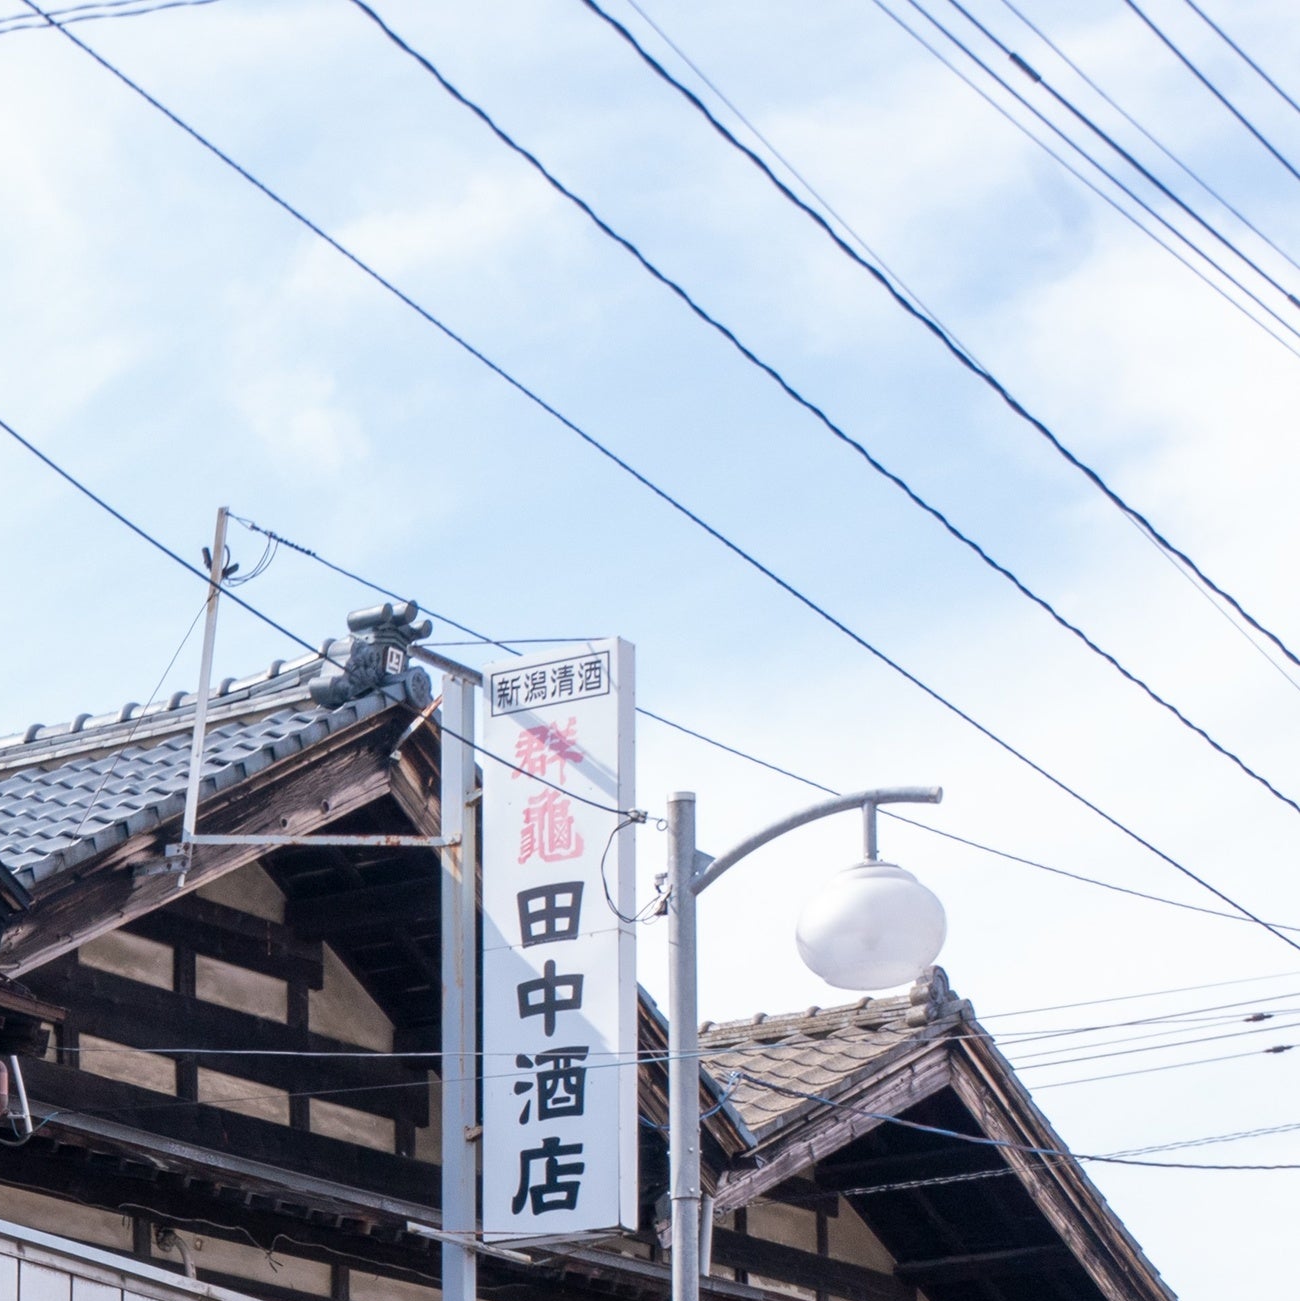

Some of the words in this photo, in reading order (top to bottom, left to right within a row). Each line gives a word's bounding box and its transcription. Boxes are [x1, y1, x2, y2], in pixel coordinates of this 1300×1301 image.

[497, 658, 604, 709] 新潟清酒
[512, 880, 590, 1216] 田中酒店
